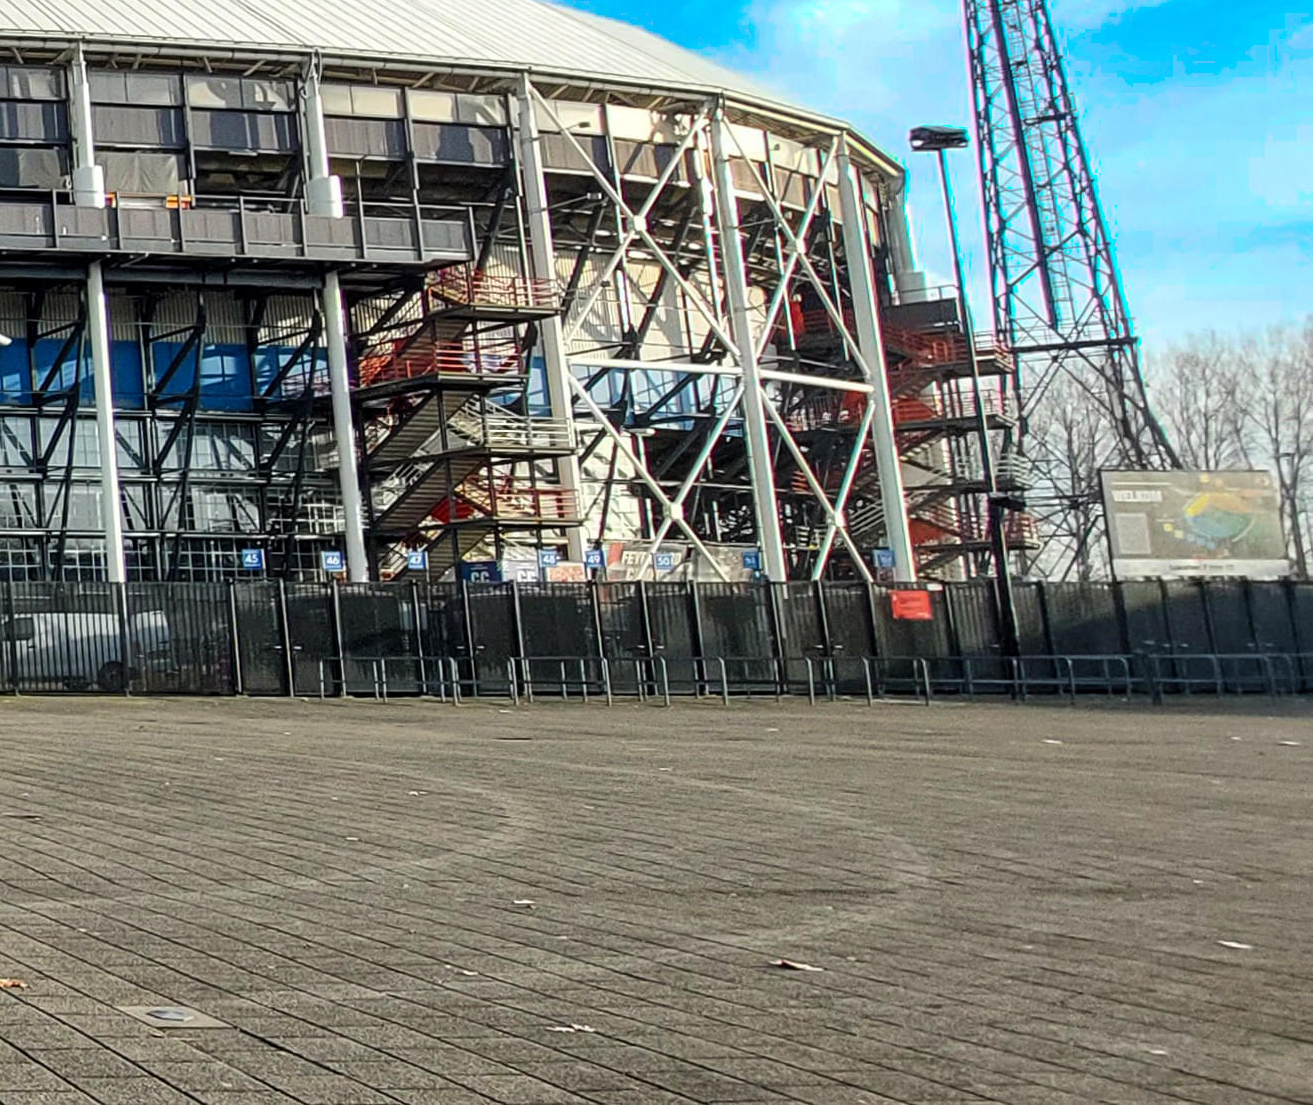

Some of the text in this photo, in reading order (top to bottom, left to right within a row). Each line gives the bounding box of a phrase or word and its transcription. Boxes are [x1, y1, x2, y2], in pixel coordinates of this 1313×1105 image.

[245, 554, 259, 564] 45
[326, 555, 340, 565] 46
[409, 555, 422, 565] 47
[543, 555, 556, 565] 48
[588, 556, 601, 565] 49
[657, 557, 670, 565] 50
